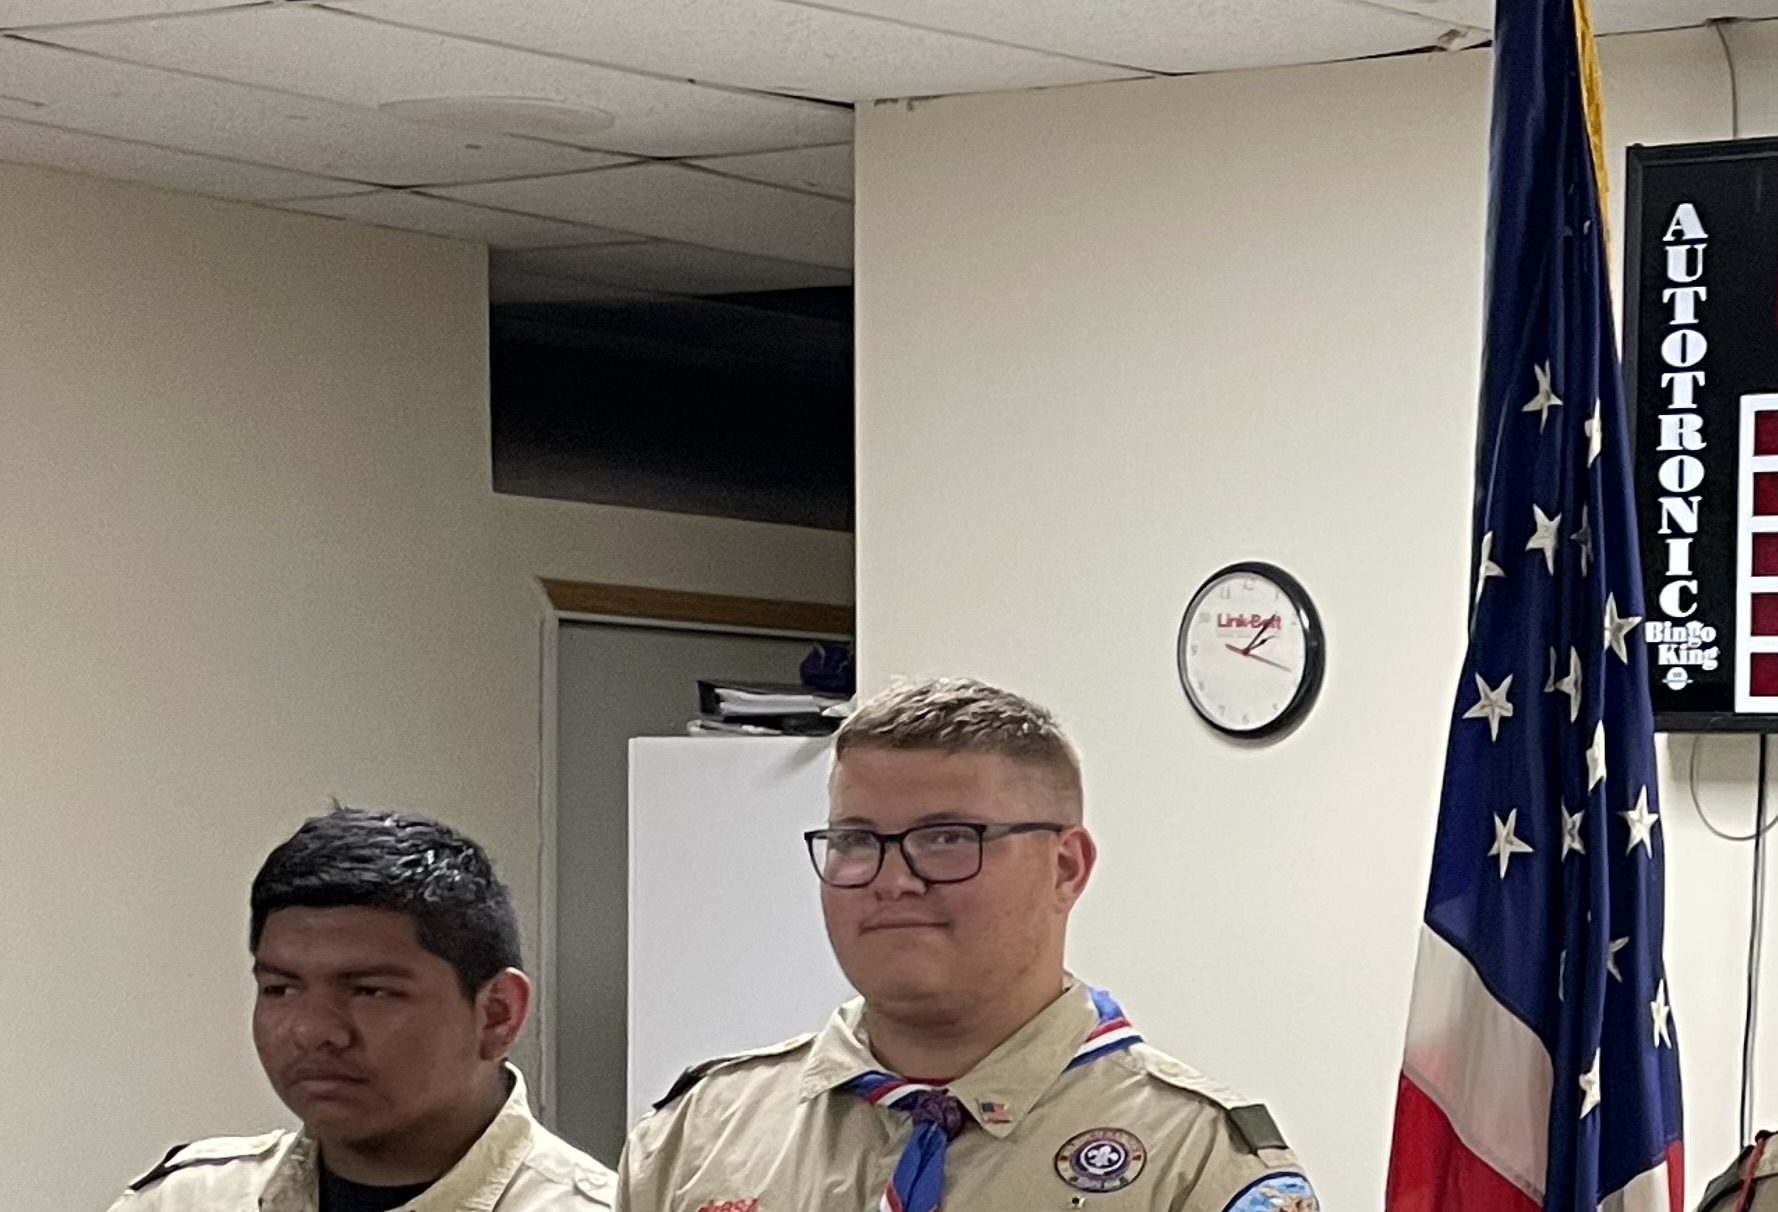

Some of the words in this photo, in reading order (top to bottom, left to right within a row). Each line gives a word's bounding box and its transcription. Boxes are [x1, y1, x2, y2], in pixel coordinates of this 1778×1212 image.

[1655, 202, 1709, 618] AUTOTRONIC
[1644, 620, 1717, 649] Bingo
[1658, 643, 1720, 671] King
